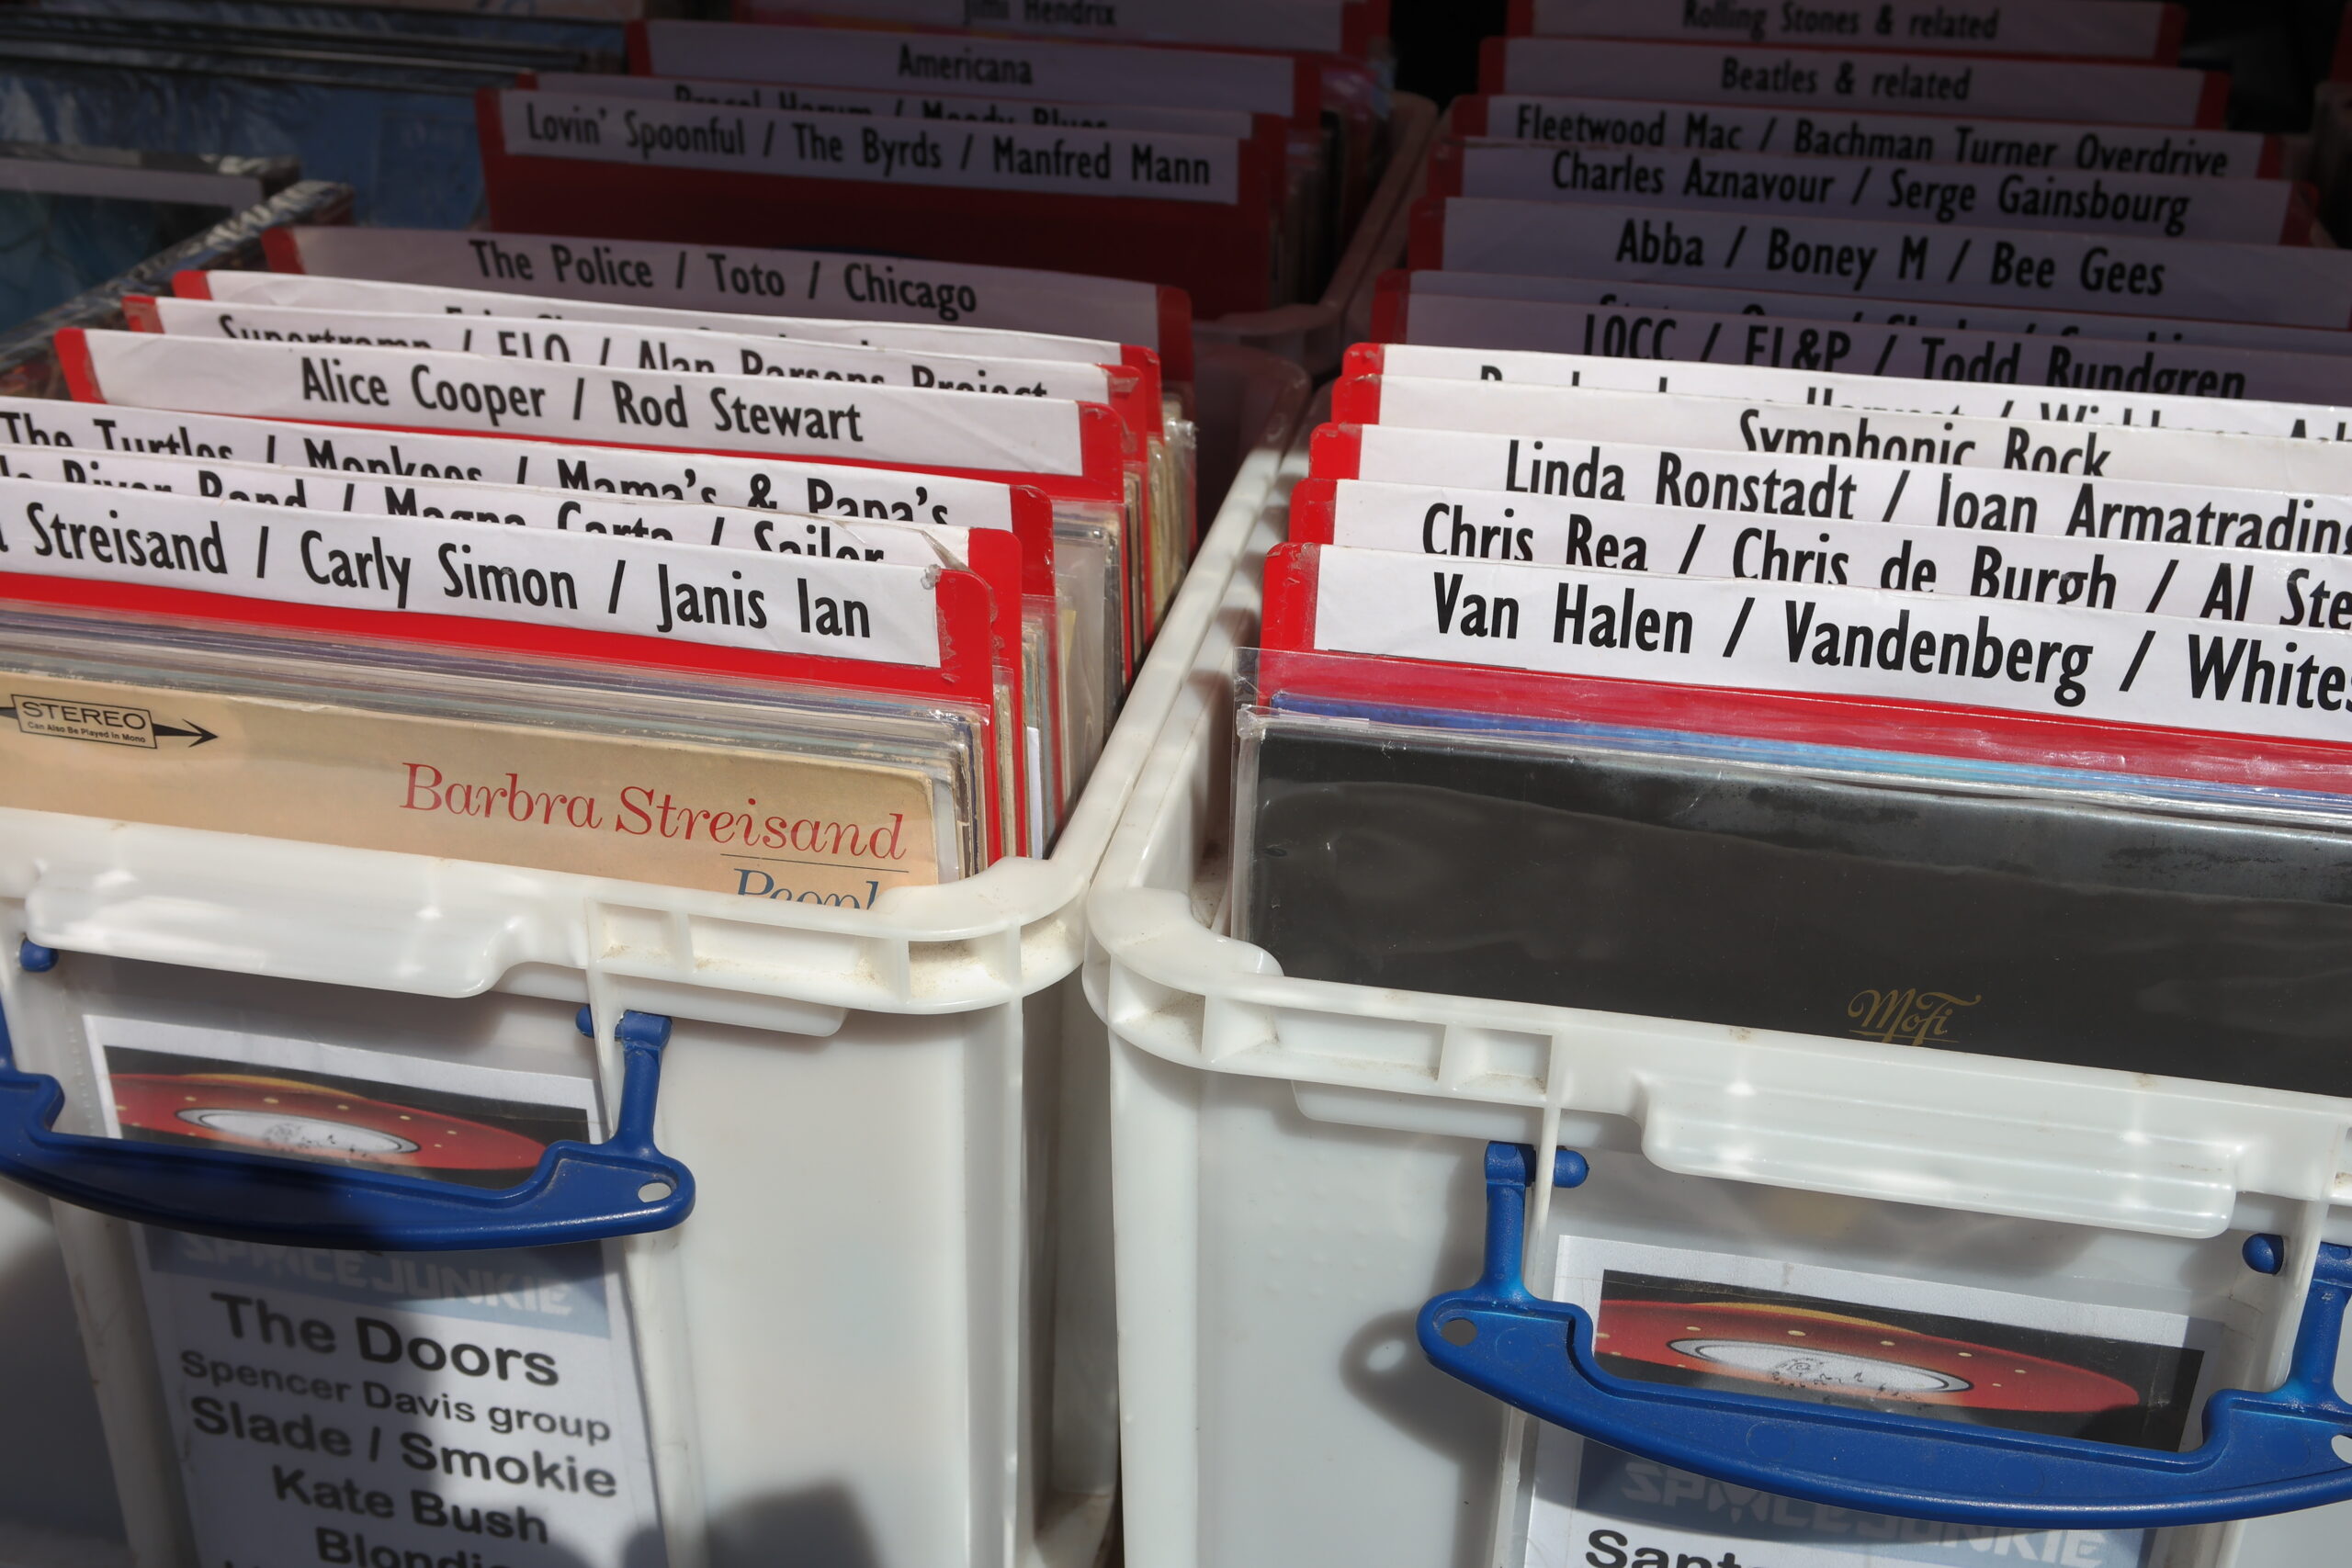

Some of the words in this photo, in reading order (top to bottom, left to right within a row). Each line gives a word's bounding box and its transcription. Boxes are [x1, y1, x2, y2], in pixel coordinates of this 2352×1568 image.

[1024, 0, 1117, 26] Hendrix
[1781, 2, 1859, 35] Stones
[1875, 6, 1894, 36] &
[1910, 9, 1999, 39] related
[898, 43, 1034, 85] Americana
[1722, 57, 1818, 94] Beatles
[1835, 62, 1855, 94] &
[1872, 65, 1972, 100] related
[526, 102, 607, 144] Lovin'
[625, 110, 746, 160] Spoonful
[792, 122, 844, 163] The
[862, 127, 942, 177] Byrds
[993, 136, 1111, 180] Manfred
[1131, 142, 1211, 185] Mann
[1517, 104, 1666, 148] Fleetwood
[1685, 112, 1742, 152] Mac
[1794, 119, 1934, 162] Bachman
[1955, 127, 2058, 168] Turner
[2075, 133, 2228, 177] Overdrive
[1553, 150, 1665, 195] Charles
[1683, 156, 1835, 203] Aznavour
[1888, 168, 1975, 223] Serge
[1998, 174, 2192, 237] Gainsbourg
[469, 239, 533, 282] The
[551, 243, 654, 288] Police
[707, 253, 786, 298] Toto
[843, 262, 978, 321] Chicago
[1615, 219, 1704, 266] Abba
[1767, 227, 1877, 291] Boney
[1898, 235, 1928, 281] M
[1990, 241, 2055, 289] Bee
[2080, 246, 2165, 297] Gees
[1582, 313, 1678, 361] 10CC
[1921, 337, 2022, 385] Todd
[2045, 344, 2245, 400] Rundgren
[301, 355, 390, 407] Alice
[410, 363, 547, 428] Cooper
[611, 379, 690, 430] Rod
[708, 386, 865, 443] Stewart
[2004, 427, 2113, 477] Rock
[1504, 438, 1626, 502] Linda
[1655, 450, 1858, 521] Ronstadt
[1937, 473, 2039, 534] Joan
[2066, 483, 2352, 556] Armatradin
[26, 502, 229, 575] Streisand
[300, 529, 412, 609] Carly
[437, 542, 579, 611] Simon
[656, 562, 767, 634] Janis
[797, 577, 872, 640] Ian
[1421, 502, 1535, 562] Chris
[1566, 513, 1649, 571] Rea
[1732, 526, 1849, 590] Chris
[1881, 540, 1937, 594] de
[1970, 545, 2119, 612] Burgh
[2199, 561, 2255, 622] Al
[1433, 570, 1520, 640] Van
[1553, 581, 1693, 655] Halen
[1784, 599, 2094, 709] Vandenberg
[2188, 633, 2352, 714] White
[22, 702, 146, 730] STEREO
[28, 720, 45, 731] Can
[47, 723, 65, 735] Also
[67, 726, 80, 736] Be
[81, 728, 110, 740] Played
[122, 733, 146, 744] Mono
[399, 761, 603, 830] Barbra
[614, 785, 909, 862] Streisand
[209, 1291, 338, 1356] The
[354, 1315, 561, 1388] Doors
[180, 1348, 352, 1404] Spencer
[362, 1381, 476, 1424] Davis
[488, 1405, 612, 1448] group
[190, 1394, 353, 1459] Slade
[399, 1430, 617, 1499] Smokie
[272, 1462, 396, 1520] Kate
[410, 1488, 549, 1545] Bush
